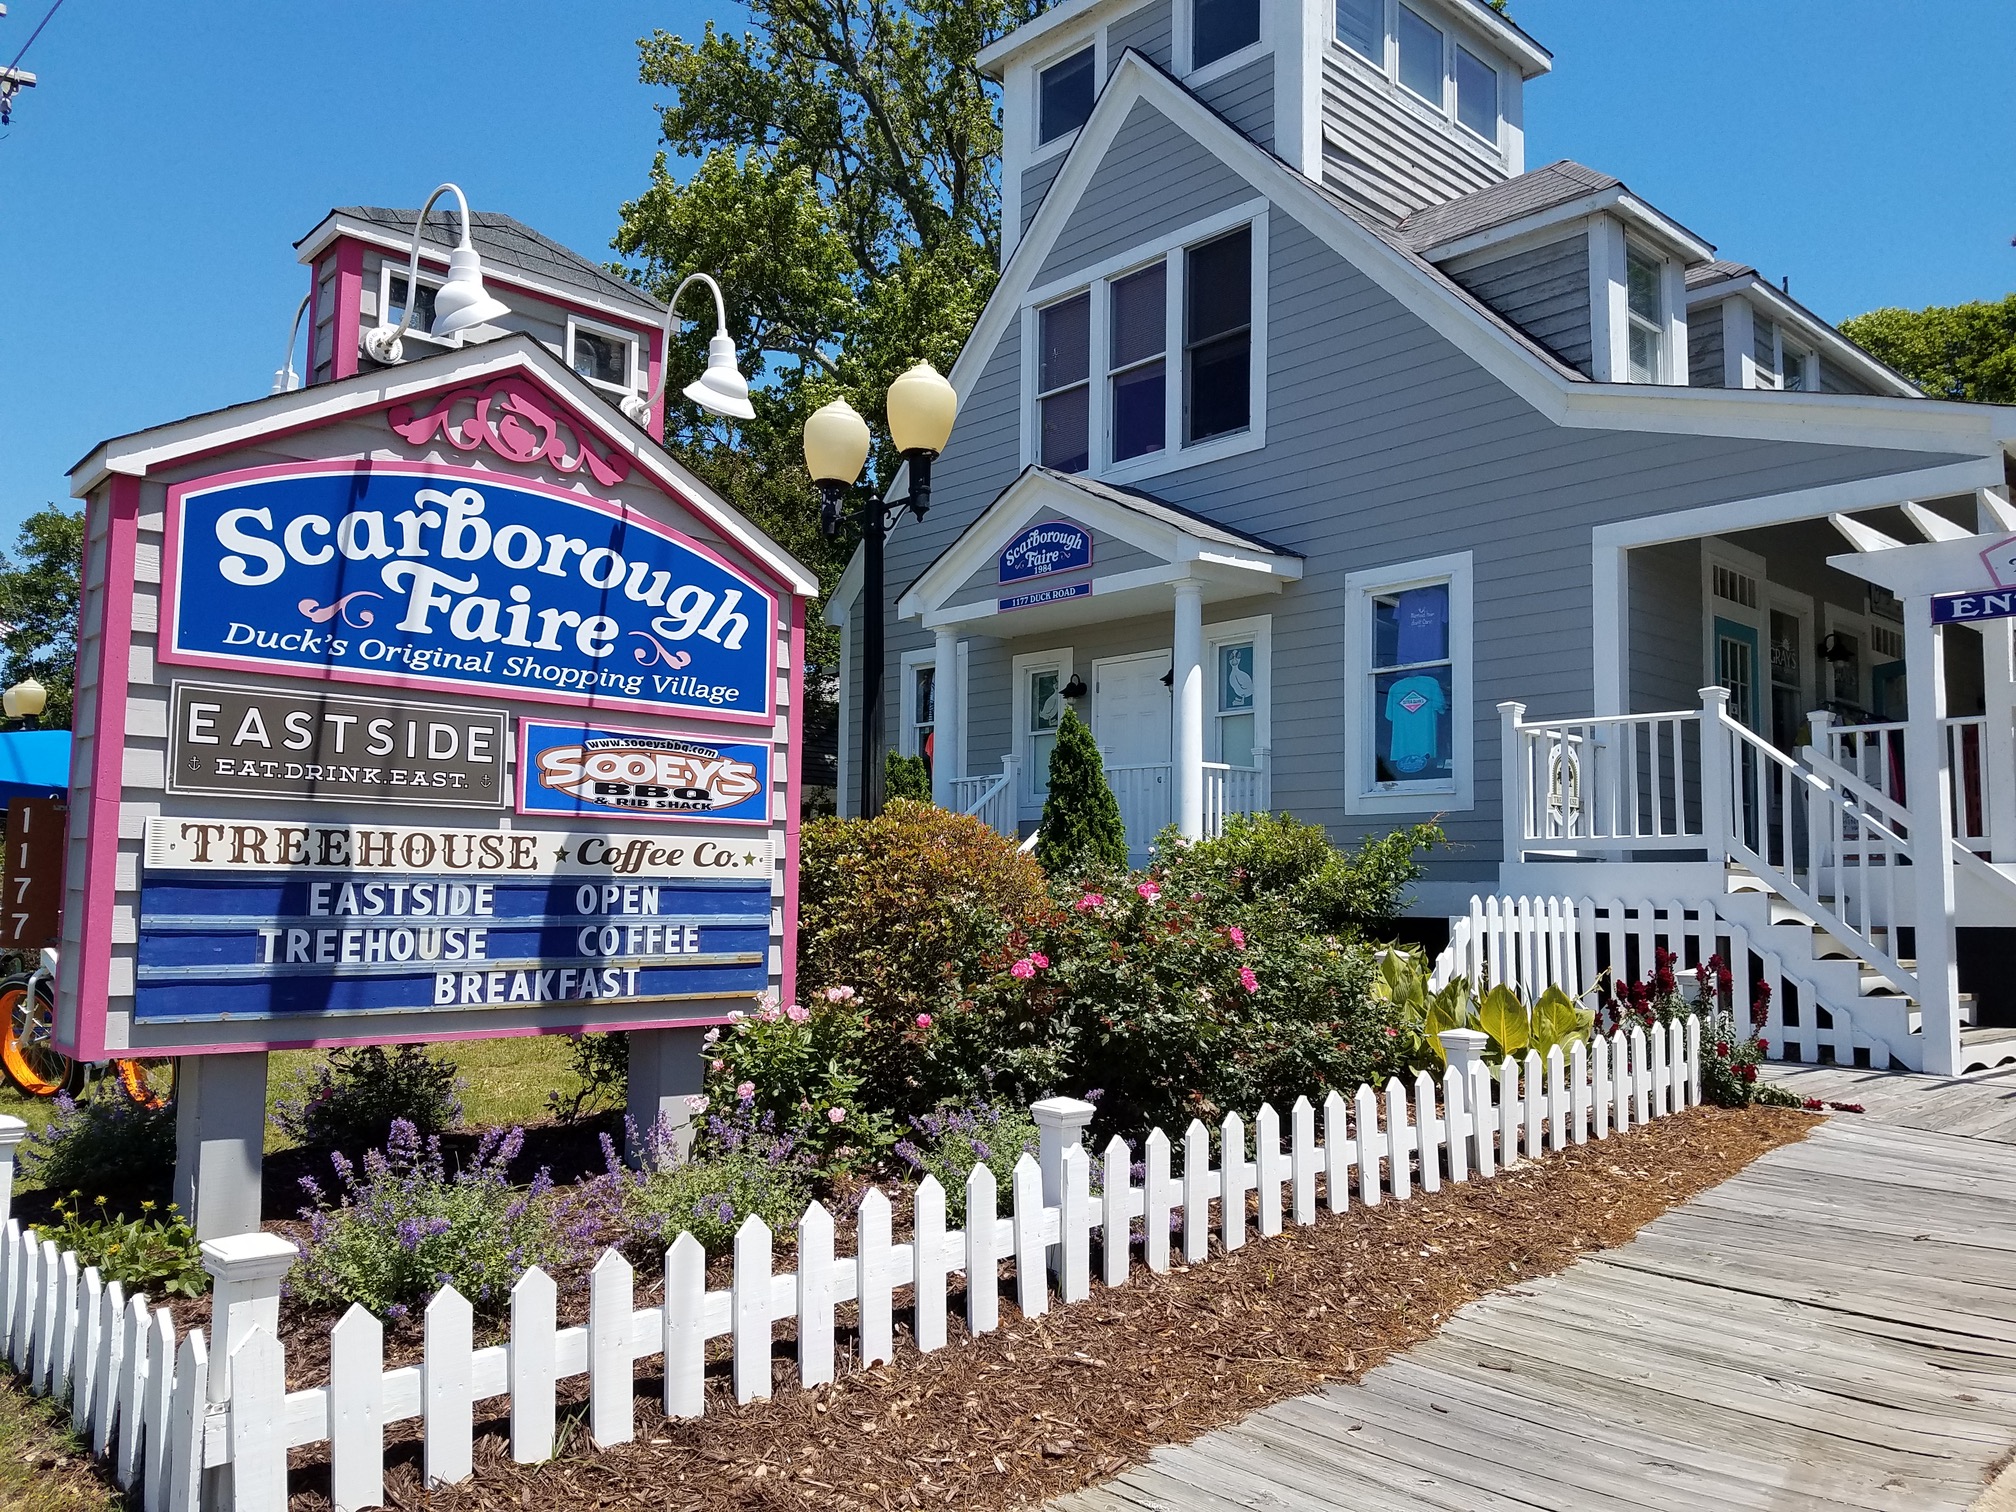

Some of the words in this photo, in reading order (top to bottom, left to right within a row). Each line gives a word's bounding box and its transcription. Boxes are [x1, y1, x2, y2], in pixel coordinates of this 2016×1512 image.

[1006, 529, 1083, 567] Scarborough
[1025, 549, 1059, 568] Faire
[215, 488, 751, 650] Scarborough
[1034, 563, 1052, 575] 1984
[381, 561, 619, 656] Faire
[1012, 596, 1029, 607] 1177
[1030, 592, 1052, 604] DUCK
[1052, 587, 1076, 600] ROAD
[1950, 593, 2016, 618] EN
[222, 622, 349, 657] Duck's
[358, 638, 495, 674] Original
[502, 656, 645, 695] Shopping
[652, 674, 740, 705] Village
[187, 701, 495, 763] EASTSIDE
[586, 738, 718, 759] www.sooeysbbq.com
[214, 757, 469, 789] EAT.DRINK.EAST.
[541, 748, 758, 793] SOOEY'S
[593, 782, 713, 801] BBQ
[593, 797, 608, 806] &
[616, 798, 649, 808] RIB
[656, 799, 713, 811] SHACK
[180, 822, 538, 871] TREEHOUSE
[576, 838, 685, 874] Coffee
[693, 841, 740, 868] Co.
[310, 881, 494, 917] EASTSIDE
[576, 884, 659, 916] OPEN
[259, 927, 488, 964] TREEHOUSE
[578, 925, 699, 957] COFFEE
[434, 966, 641, 1005] BREAKFAST
